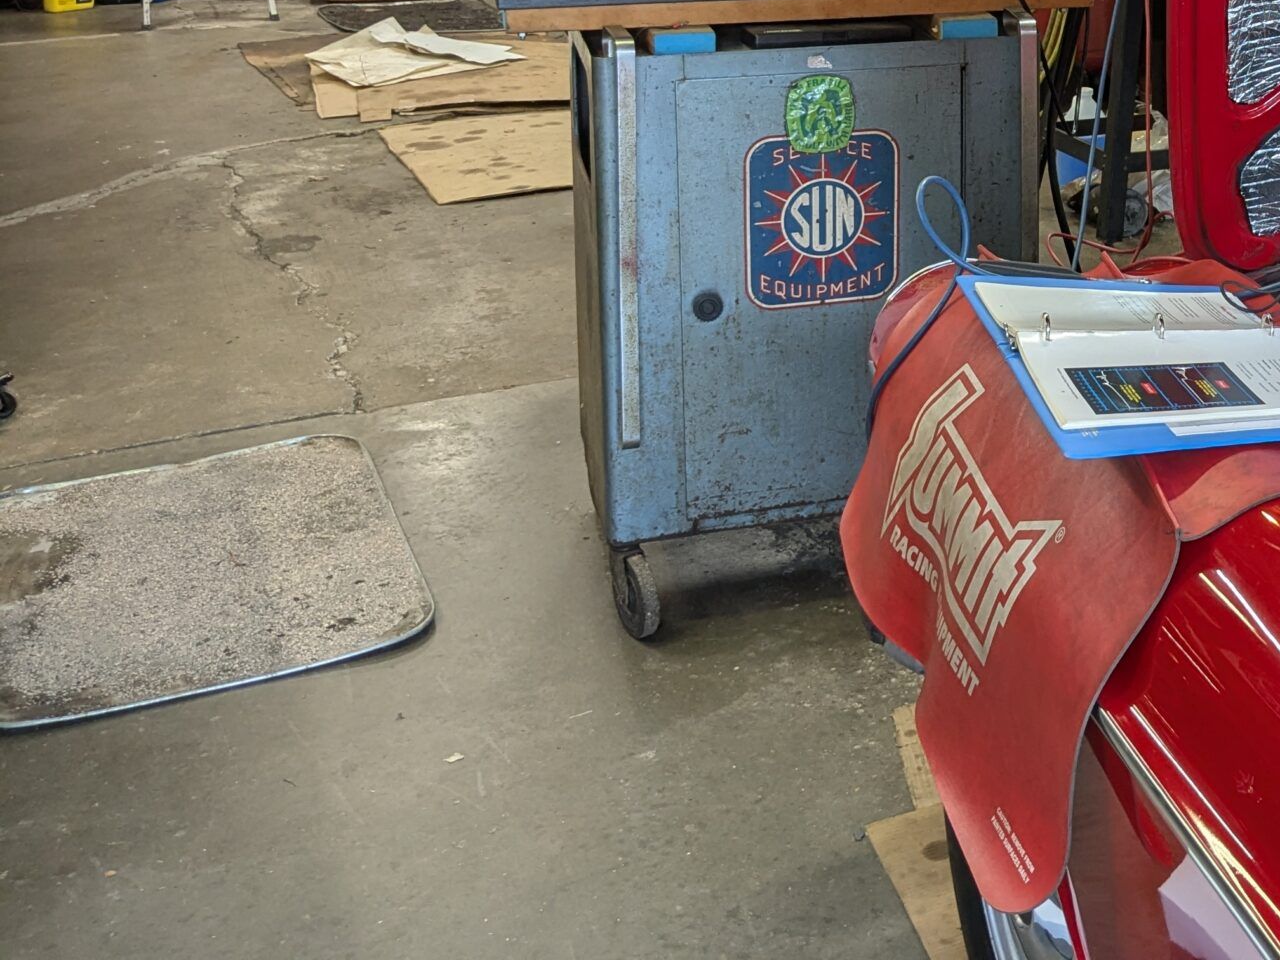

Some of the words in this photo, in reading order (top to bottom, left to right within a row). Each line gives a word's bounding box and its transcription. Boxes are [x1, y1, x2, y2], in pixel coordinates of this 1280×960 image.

[773, 142, 872, 166] SECE
[790, 185, 855, 252] SUN
[760, 263, 885, 299] EQUIPMENT
[885, 370, 1045, 645] SUMMIT
[889, 524, 938, 593] RACING
